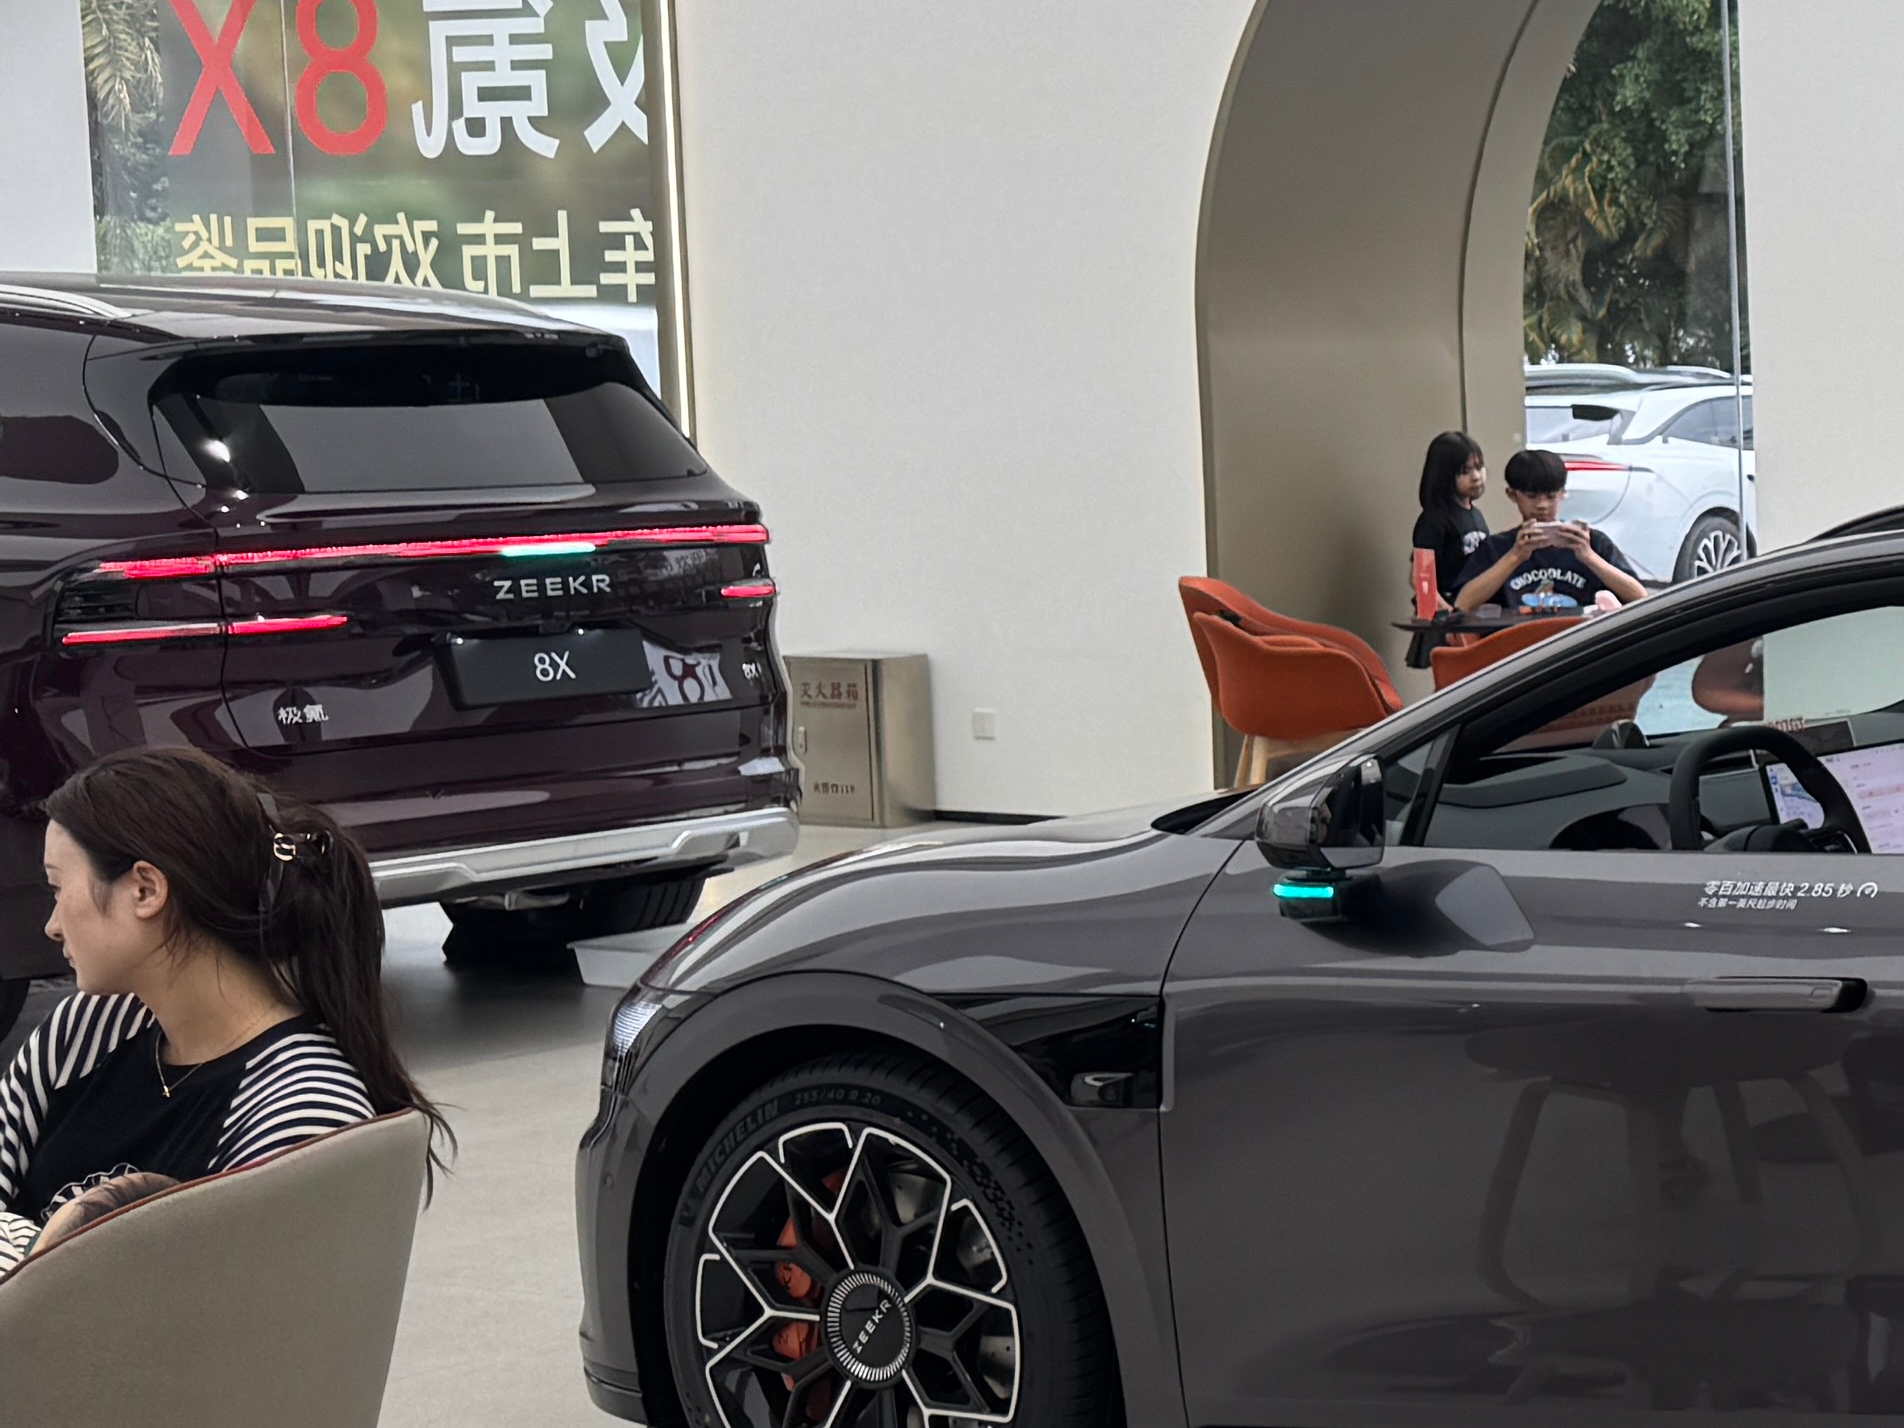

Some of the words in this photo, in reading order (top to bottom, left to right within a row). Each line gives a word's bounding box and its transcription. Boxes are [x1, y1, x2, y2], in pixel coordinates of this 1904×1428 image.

[493, 573, 611, 600] ZEEKR
[533, 650, 577, 684] 8X
[800, 681, 859, 702] 灭火器箱
[278, 704, 330, 725] 极氪
[1797, 882, 1834, 898] 2.85
[1837, 883, 1854, 899] 秒
[694, 1099, 779, 1194] MICHELIN
[794, 1088, 845, 1106] 255/40
[865, 1093, 881, 1105] 20
[853, 1299, 892, 1353] ZEEKR
